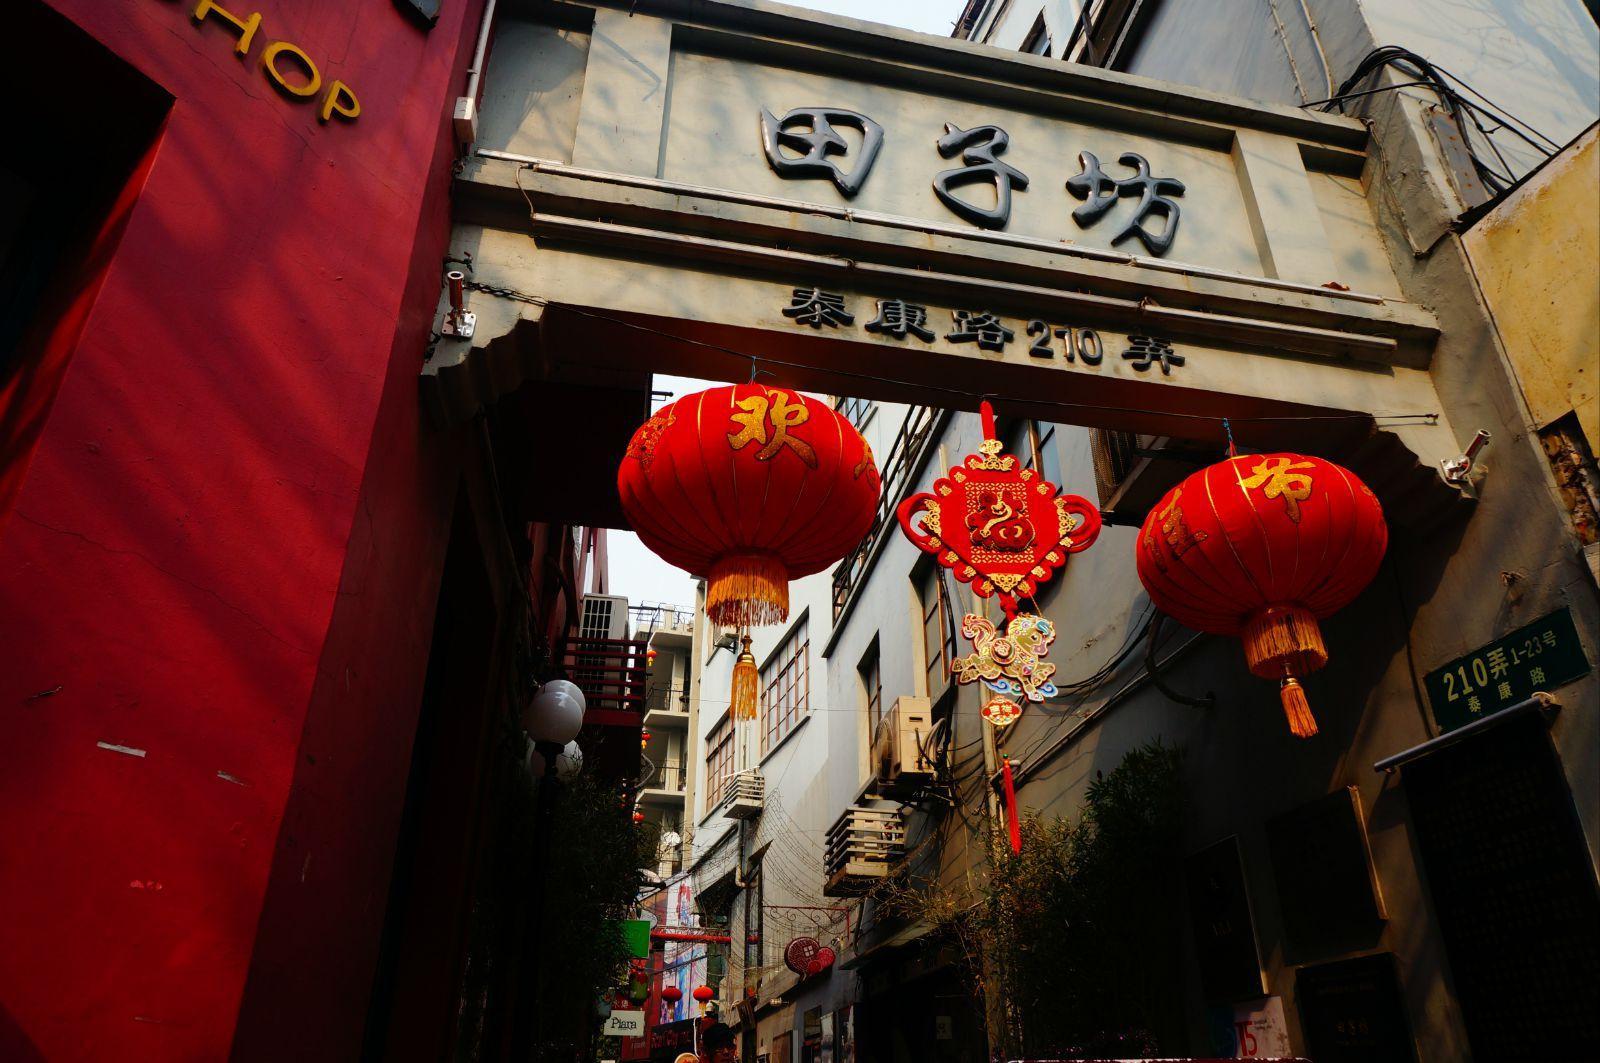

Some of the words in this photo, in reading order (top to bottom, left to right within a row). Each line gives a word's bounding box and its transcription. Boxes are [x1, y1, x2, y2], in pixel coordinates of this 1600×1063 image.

[760, 107, 1186, 257] 田子坊
[782, 287, 1186, 375] 泰康路210弄
[726, 389, 818, 469] 欢
[1443, 647, 1509, 701] 210弄
[1511, 630, 1557, 665] 1-23号
[1468, 667, 1546, 712] 泰康路
